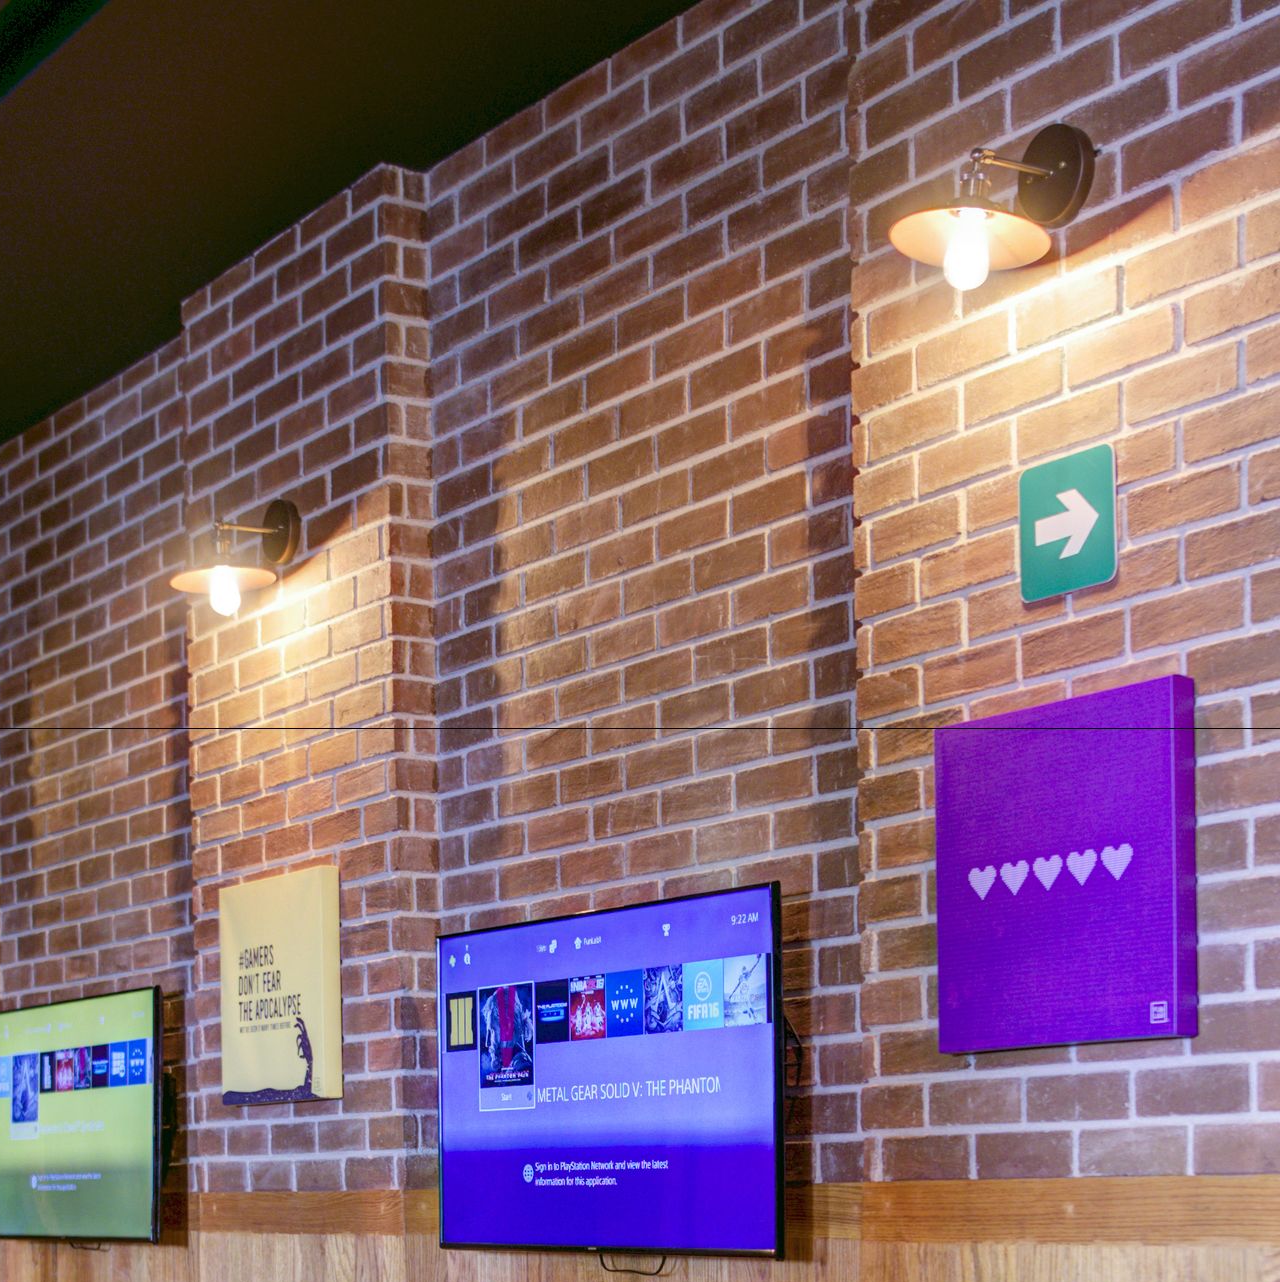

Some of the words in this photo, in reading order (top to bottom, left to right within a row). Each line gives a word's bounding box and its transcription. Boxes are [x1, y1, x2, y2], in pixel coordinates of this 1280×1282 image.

[730, 913, 748, 926] 9:22
[748, 912, 759, 924] AM
[239, 945, 274, 970] #GAMERS
[238, 973, 260, 996] DON'T
[263, 970, 281, 993] FEAR
[239, 1000, 253, 1022] THE
[255, 994, 301, 1020] APOCALYPSE
[687, 1003, 708, 1020] FIFA
[709, 1002, 720, 1018] 16
[537, 1086, 569, 1103] METAL
[571, 1085, 599, 1101] GEAR
[600, 1082, 630, 1100] SOLID
[631, 1081, 643, 1097] V:
[645, 1079, 667, 1096] THE
[535, 1162, 546, 1173] Sign
[560, 1161, 590, 1172] PlayStation
[591, 1160, 614, 1171] Network
[615, 1160, 626, 1170] and
[627, 1160, 640, 1170] view
[641, 1160, 651, 1170] the
[652, 1159, 669, 1170] latest
[535, 1176, 565, 1187] information
[566, 1176, 574, 1186] for
[575, 1176, 585, 1186] this
[585, 1176, 617, 1187] application.
